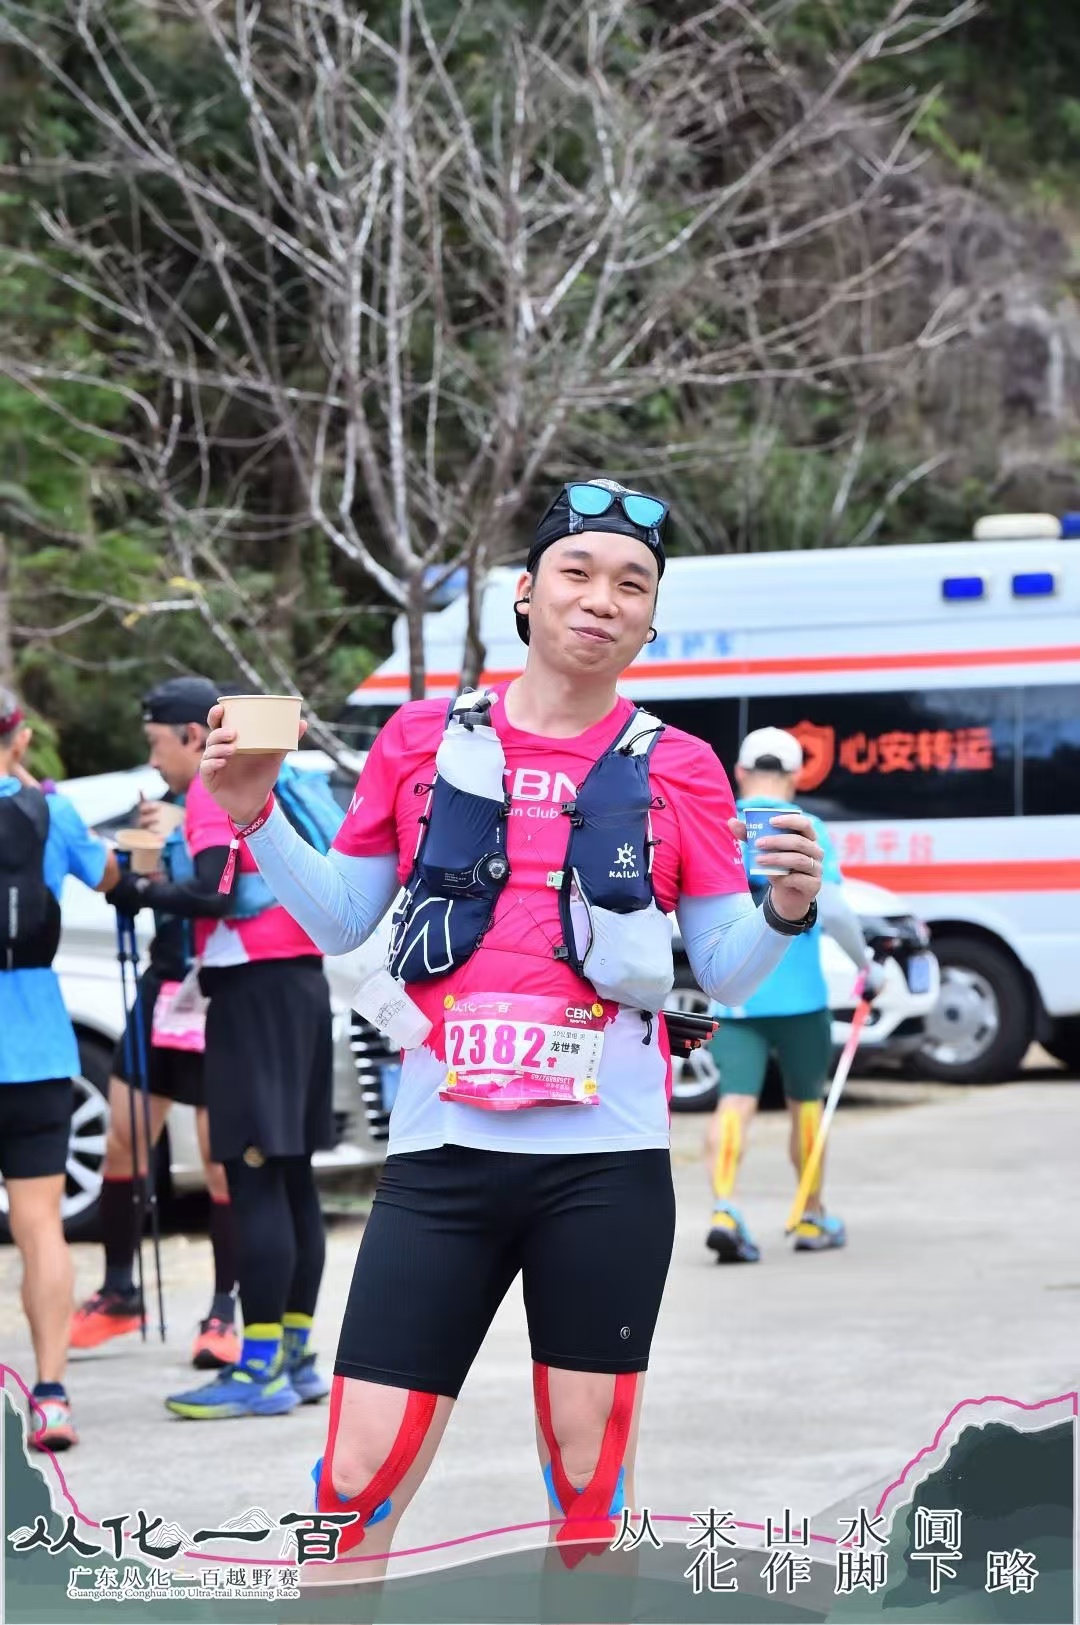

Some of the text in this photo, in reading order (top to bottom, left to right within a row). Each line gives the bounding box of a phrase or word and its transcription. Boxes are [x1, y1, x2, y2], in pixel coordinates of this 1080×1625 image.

[839, 727, 993, 773] 心安转运
[503, 768, 579, 803] BN
[527, 806, 559, 819] Club
[609, 870, 639, 879] KAILAS
[565, 1007, 593, 1020] CBN
[450, 1023, 546, 1069] 2382
